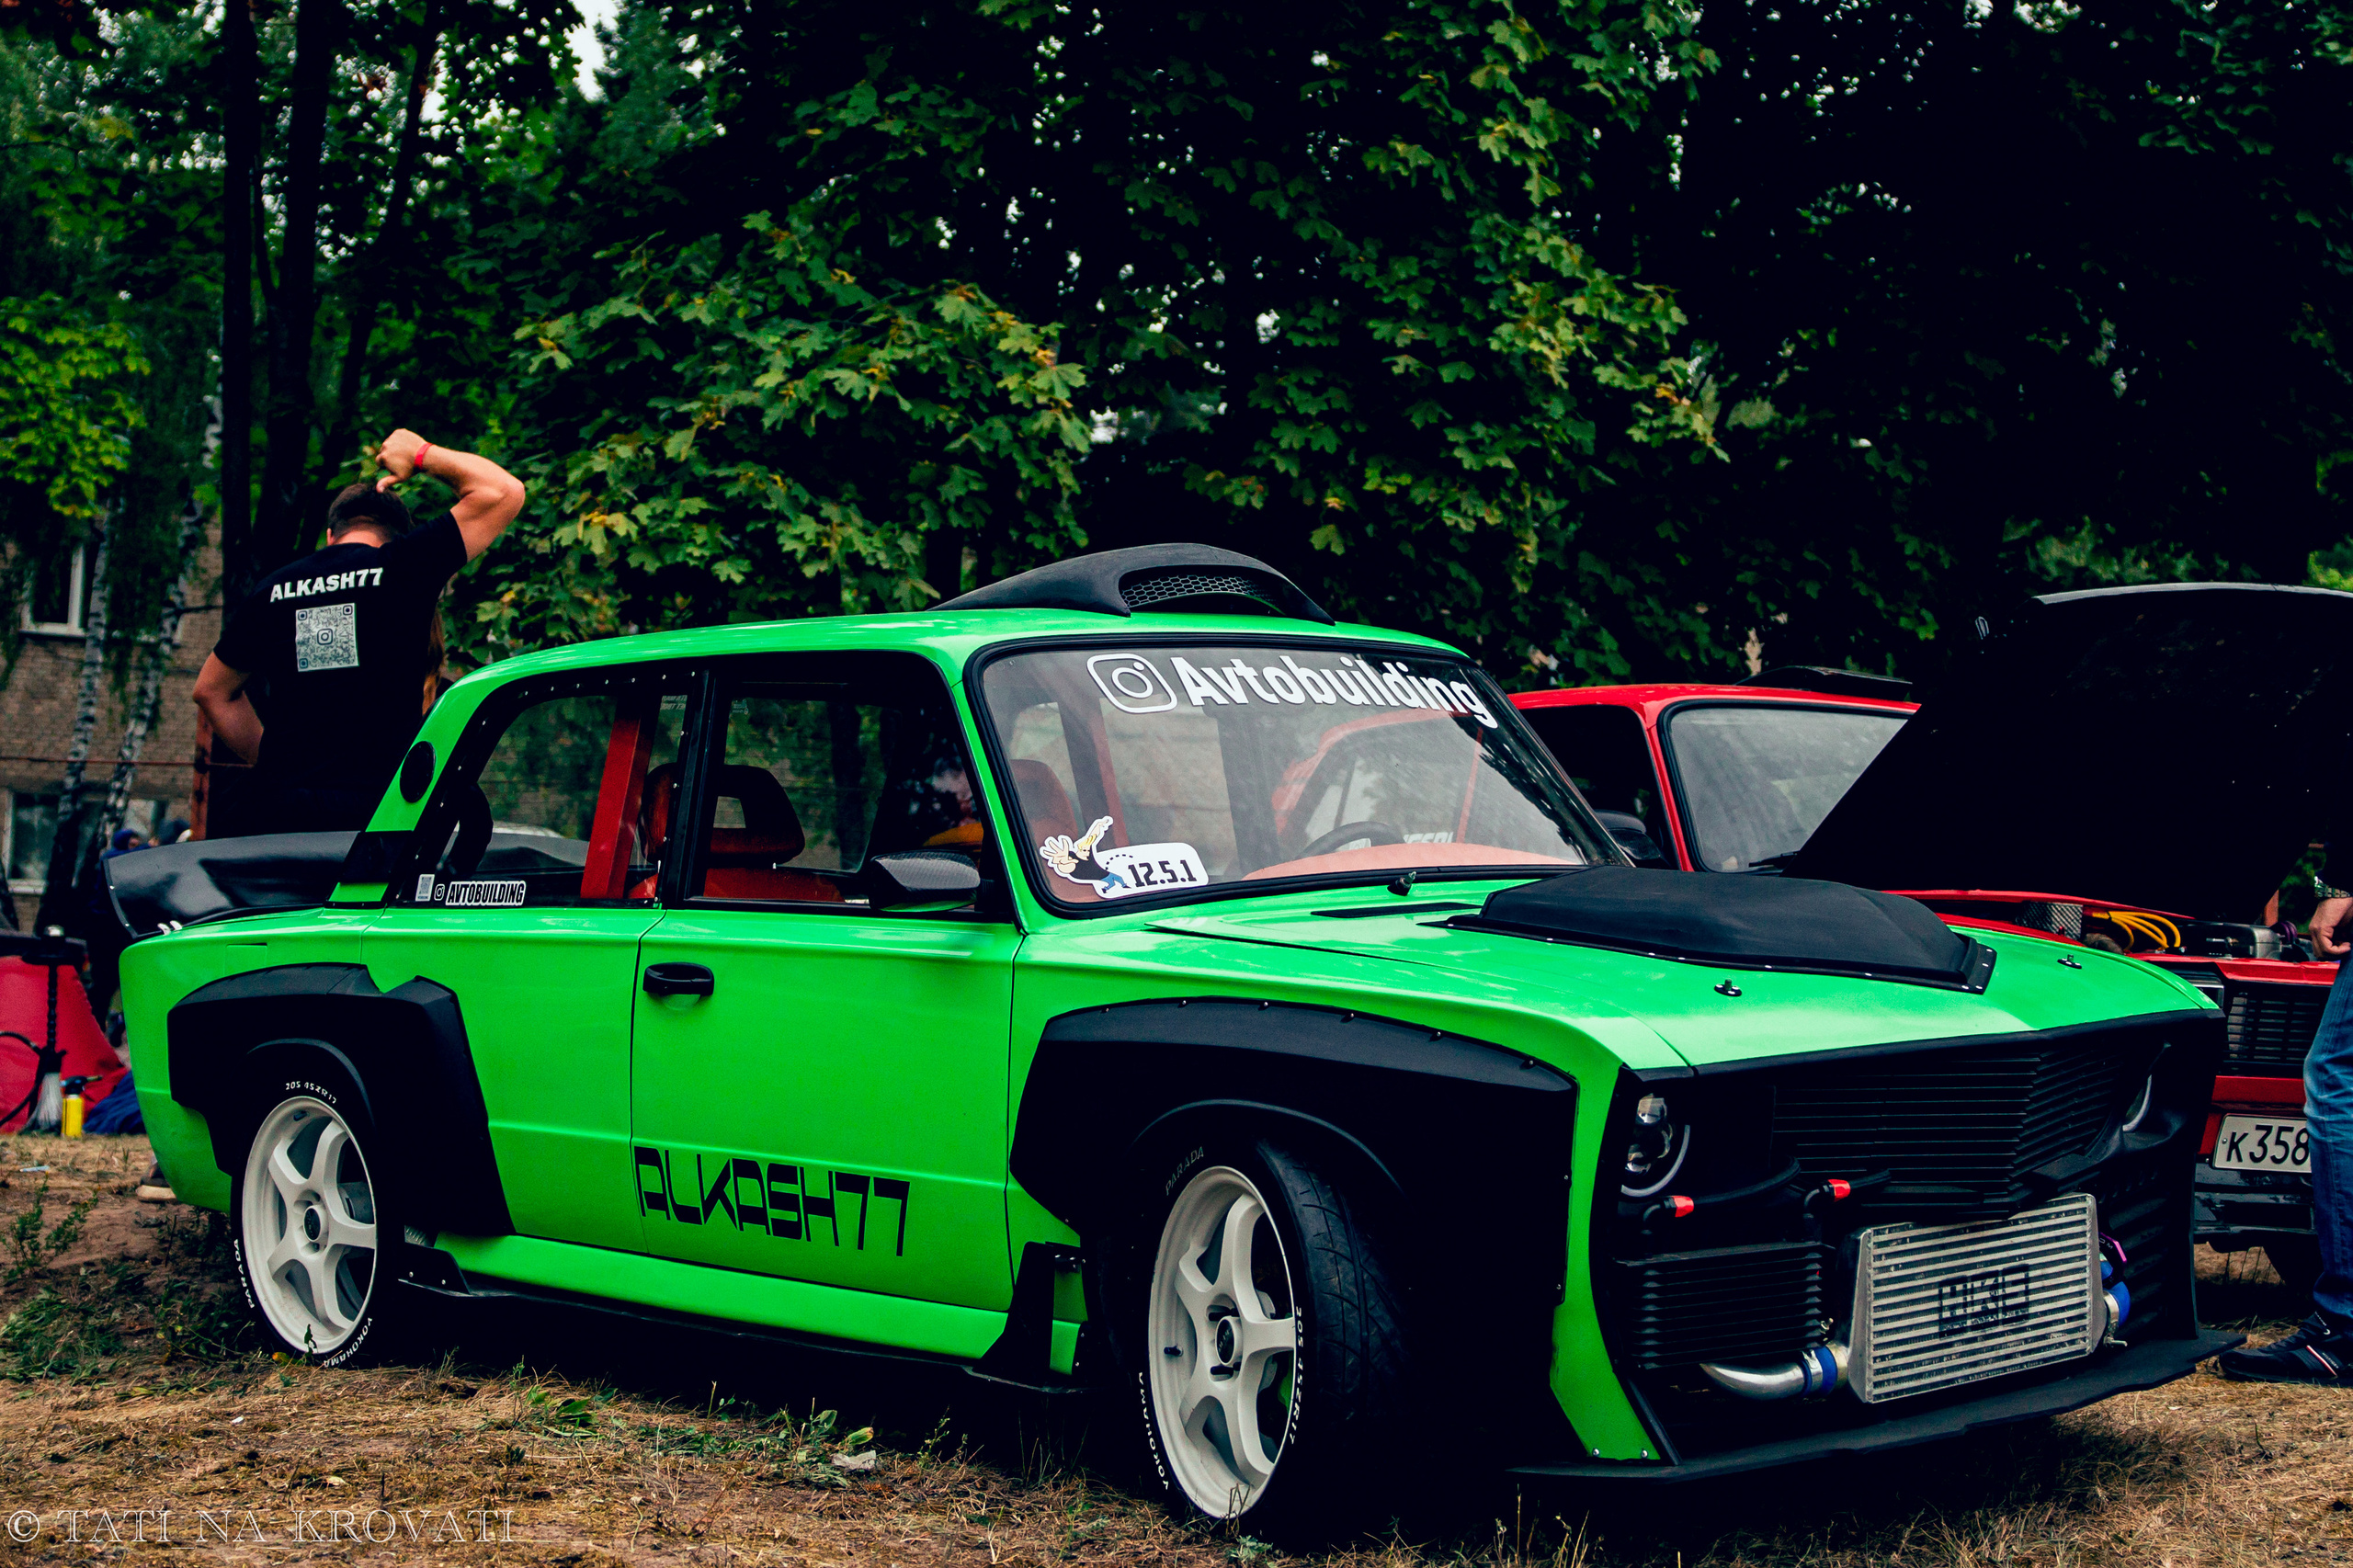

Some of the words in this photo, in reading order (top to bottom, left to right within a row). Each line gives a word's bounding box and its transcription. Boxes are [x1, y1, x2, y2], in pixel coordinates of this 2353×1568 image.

[270, 567, 383, 603] ALKASH77
[1170, 655, 1499, 729] Avtobuilding
[447, 881, 526, 905] AVTOBUILDING
[1128, 859, 1198, 888] 12.5.1
[285, 1080, 301, 1091] 205
[1165, 1145, 1204, 1197] PARADA
[634, 1145, 910, 1256] ALKASH77
[324, 1317, 373, 1368] YOKOHAMA
[1139, 1371, 1169, 1490] YOKOHAMA
